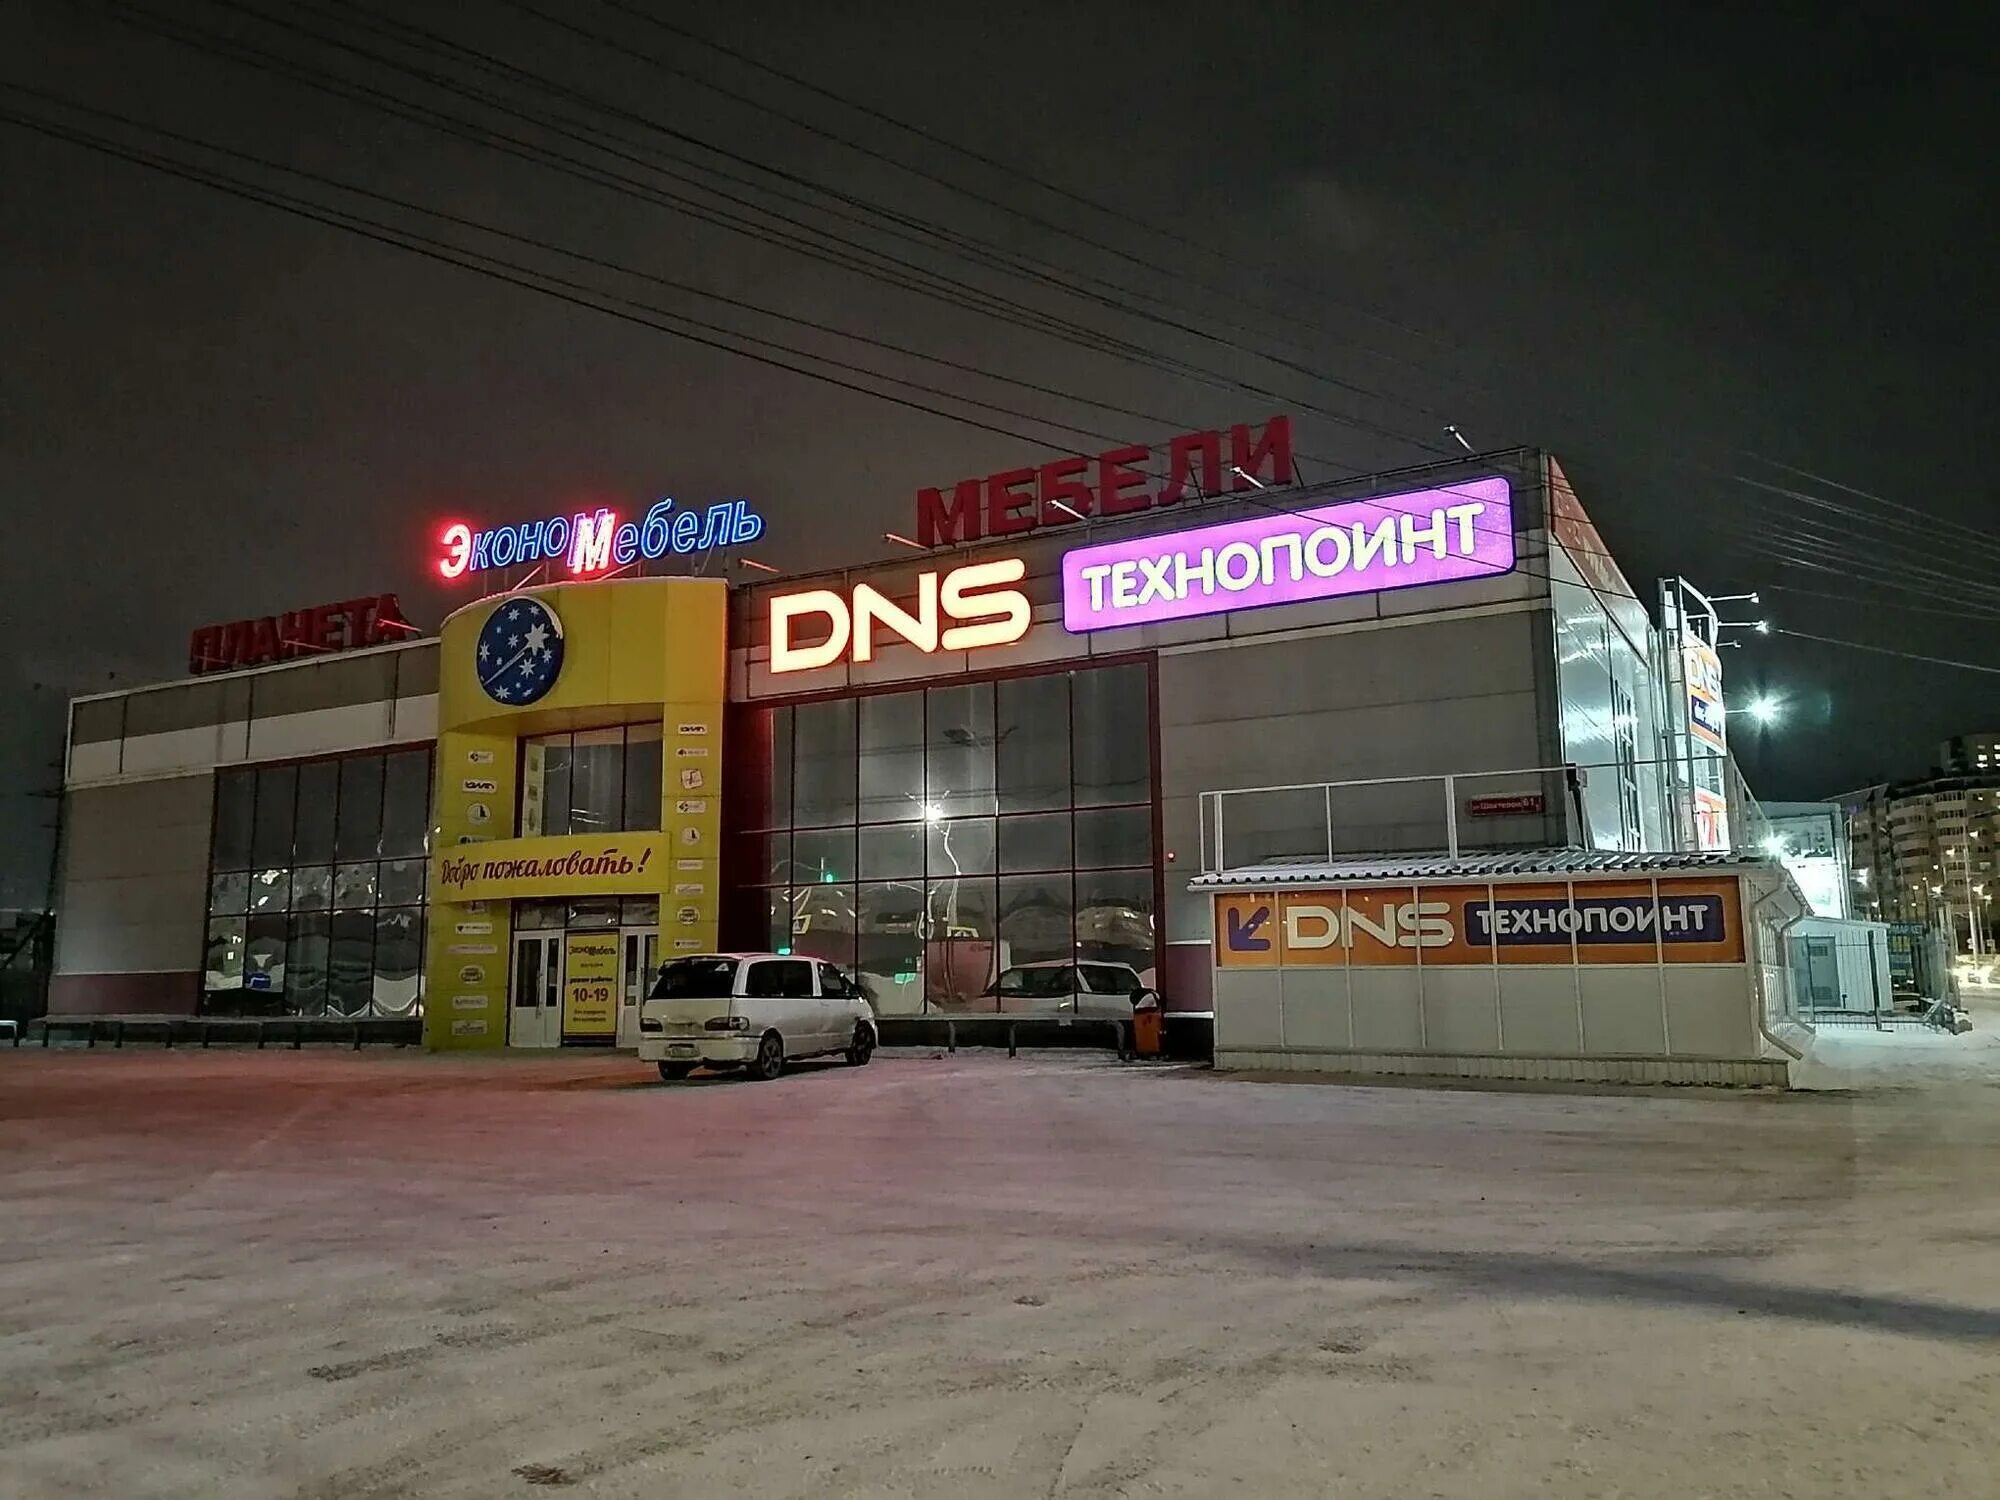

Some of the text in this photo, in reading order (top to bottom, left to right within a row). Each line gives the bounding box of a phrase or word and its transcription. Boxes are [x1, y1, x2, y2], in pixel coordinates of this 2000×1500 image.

[917, 415, 1293, 549] МЕБЕЛИ
[438, 496, 765, 578] ЭконоМебель
[1081, 502, 1486, 612] ТЕХНОПОИНТ
[189, 592, 411, 675] ПЛАНЕТА
[769, 557, 1033, 674] DNS
[441, 855, 480, 890] Добро
[1285, 902, 1454, 949] DNS
[1475, 904, 1710, 935] ТЕХНОПОИНТ
[573, 987, 609, 1003] 10-19
